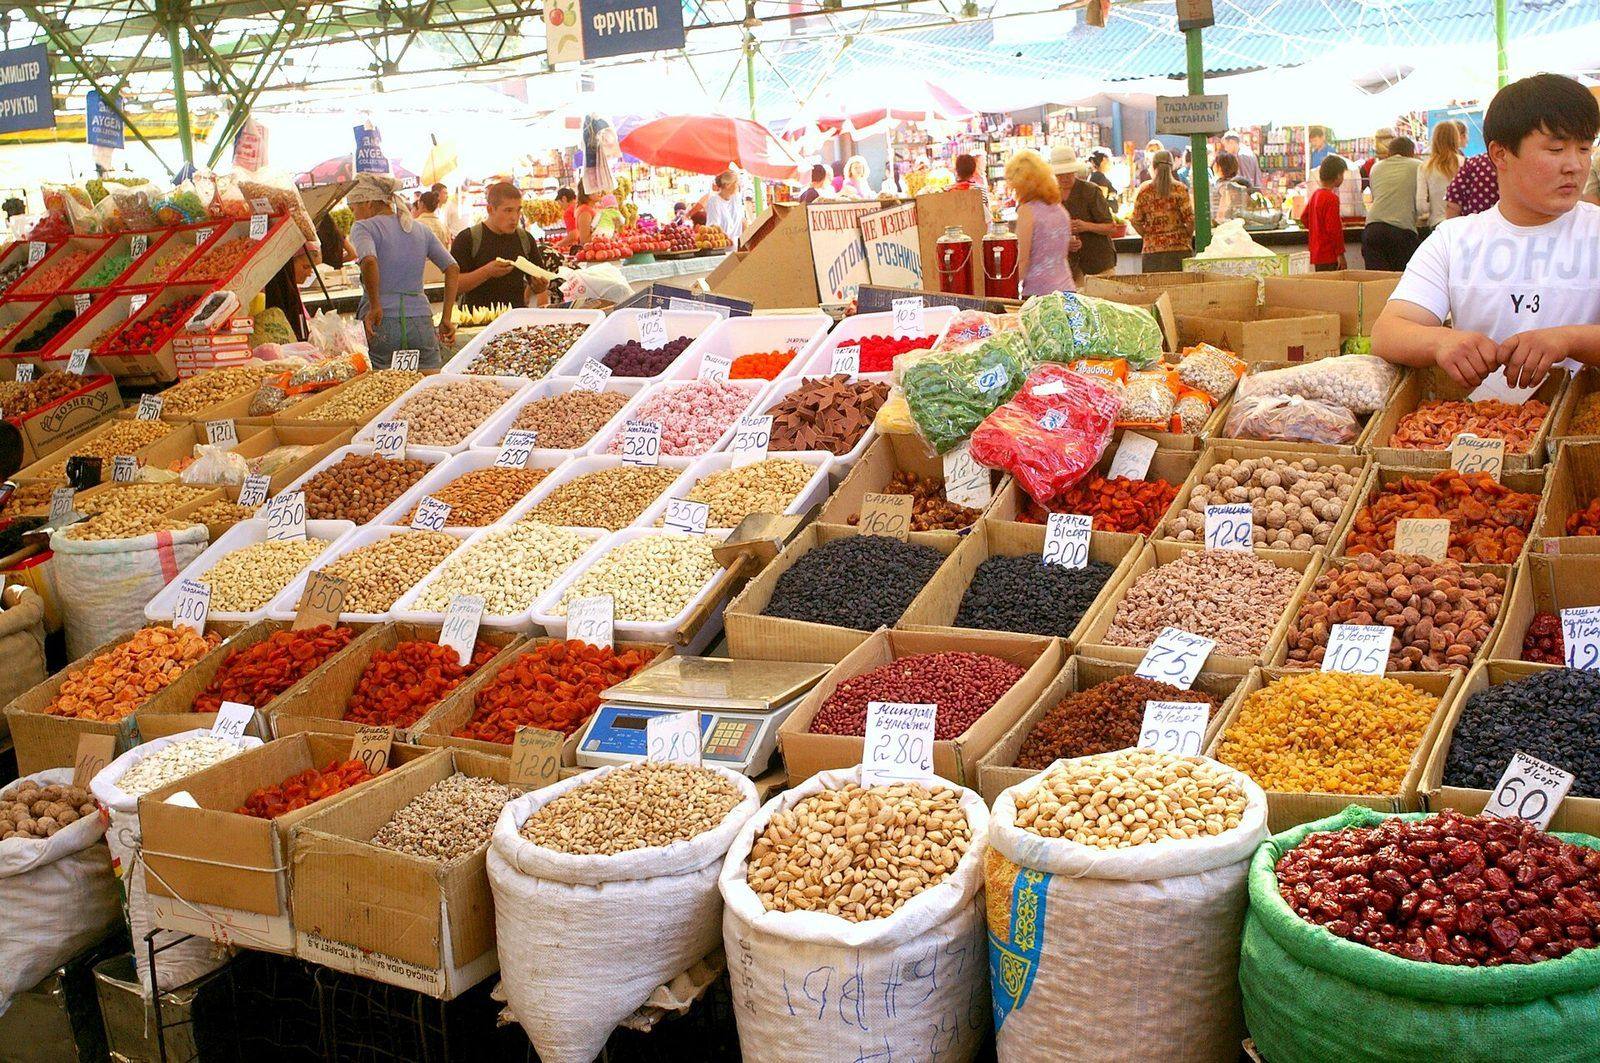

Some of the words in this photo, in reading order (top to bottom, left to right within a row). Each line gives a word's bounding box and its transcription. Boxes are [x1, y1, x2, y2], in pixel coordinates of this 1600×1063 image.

[593, 5, 658, 37] ФРУКТЫ
[1163, 101, 1223, 112] ТАЗАЛЫКТЫ
[1458, 236, 1599, 282] YOHJI
[1510, 294, 1540, 313] Y-3
[55, 397, 94, 421] ROSHEN
[375, 433, 403, 451] 300
[624, 436, 658, 457] 320
[735, 431, 769, 452] 350
[267, 503, 304, 530] 350
[414, 508, 446, 532] 350
[1043, 540, 1087, 566] 200
[177, 597, 205, 621] 180
[304, 581, 343, 613] 150
[1145, 645, 1198, 676] 75
[1326, 643, 1386, 674] 105
[650, 730, 698, 761] 280
[515, 752, 556, 779] 120
[1497, 776, 1549, 821] 60
